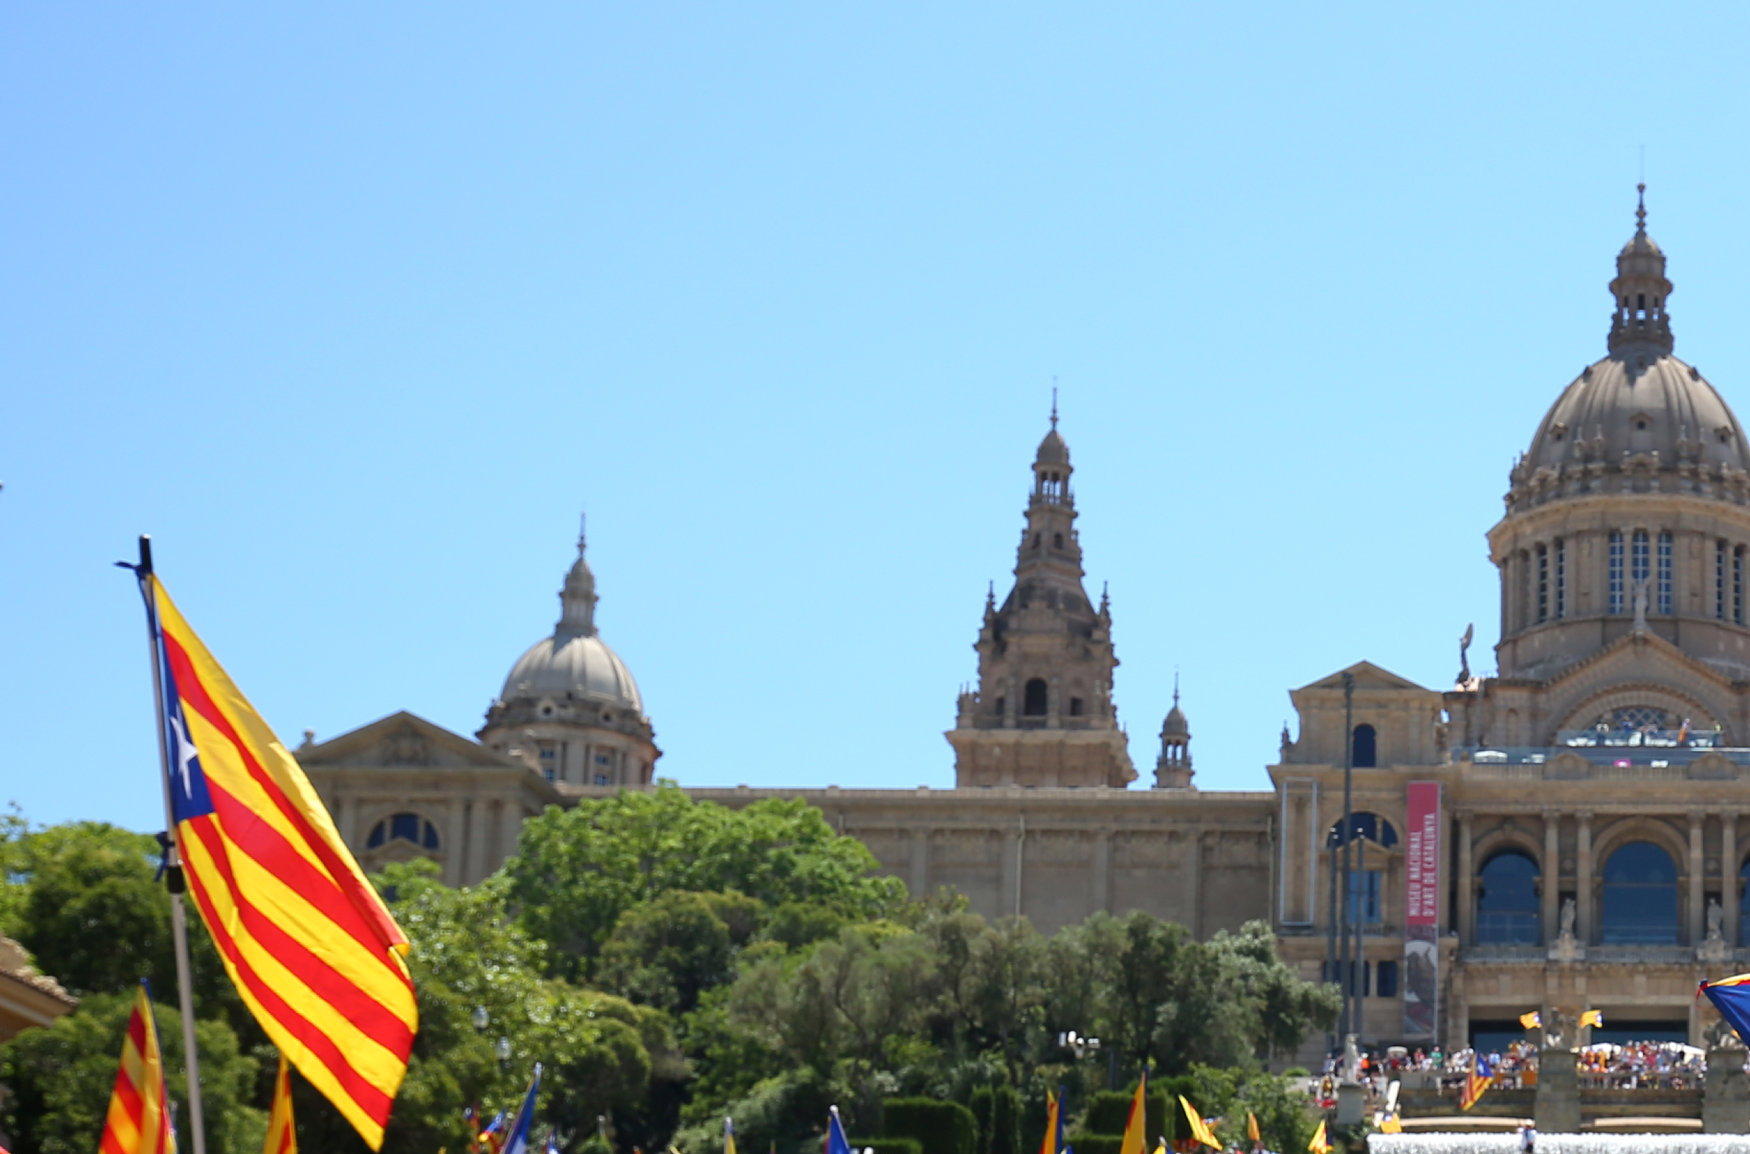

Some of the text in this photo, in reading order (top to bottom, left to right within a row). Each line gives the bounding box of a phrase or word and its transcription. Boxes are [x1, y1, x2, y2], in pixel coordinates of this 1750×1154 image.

[1422, 812, 1435, 869] CATALUNYA
[1408, 831, 1421, 917] MUSEU NACIONAL
[1422, 872, 1435, 885] DE
